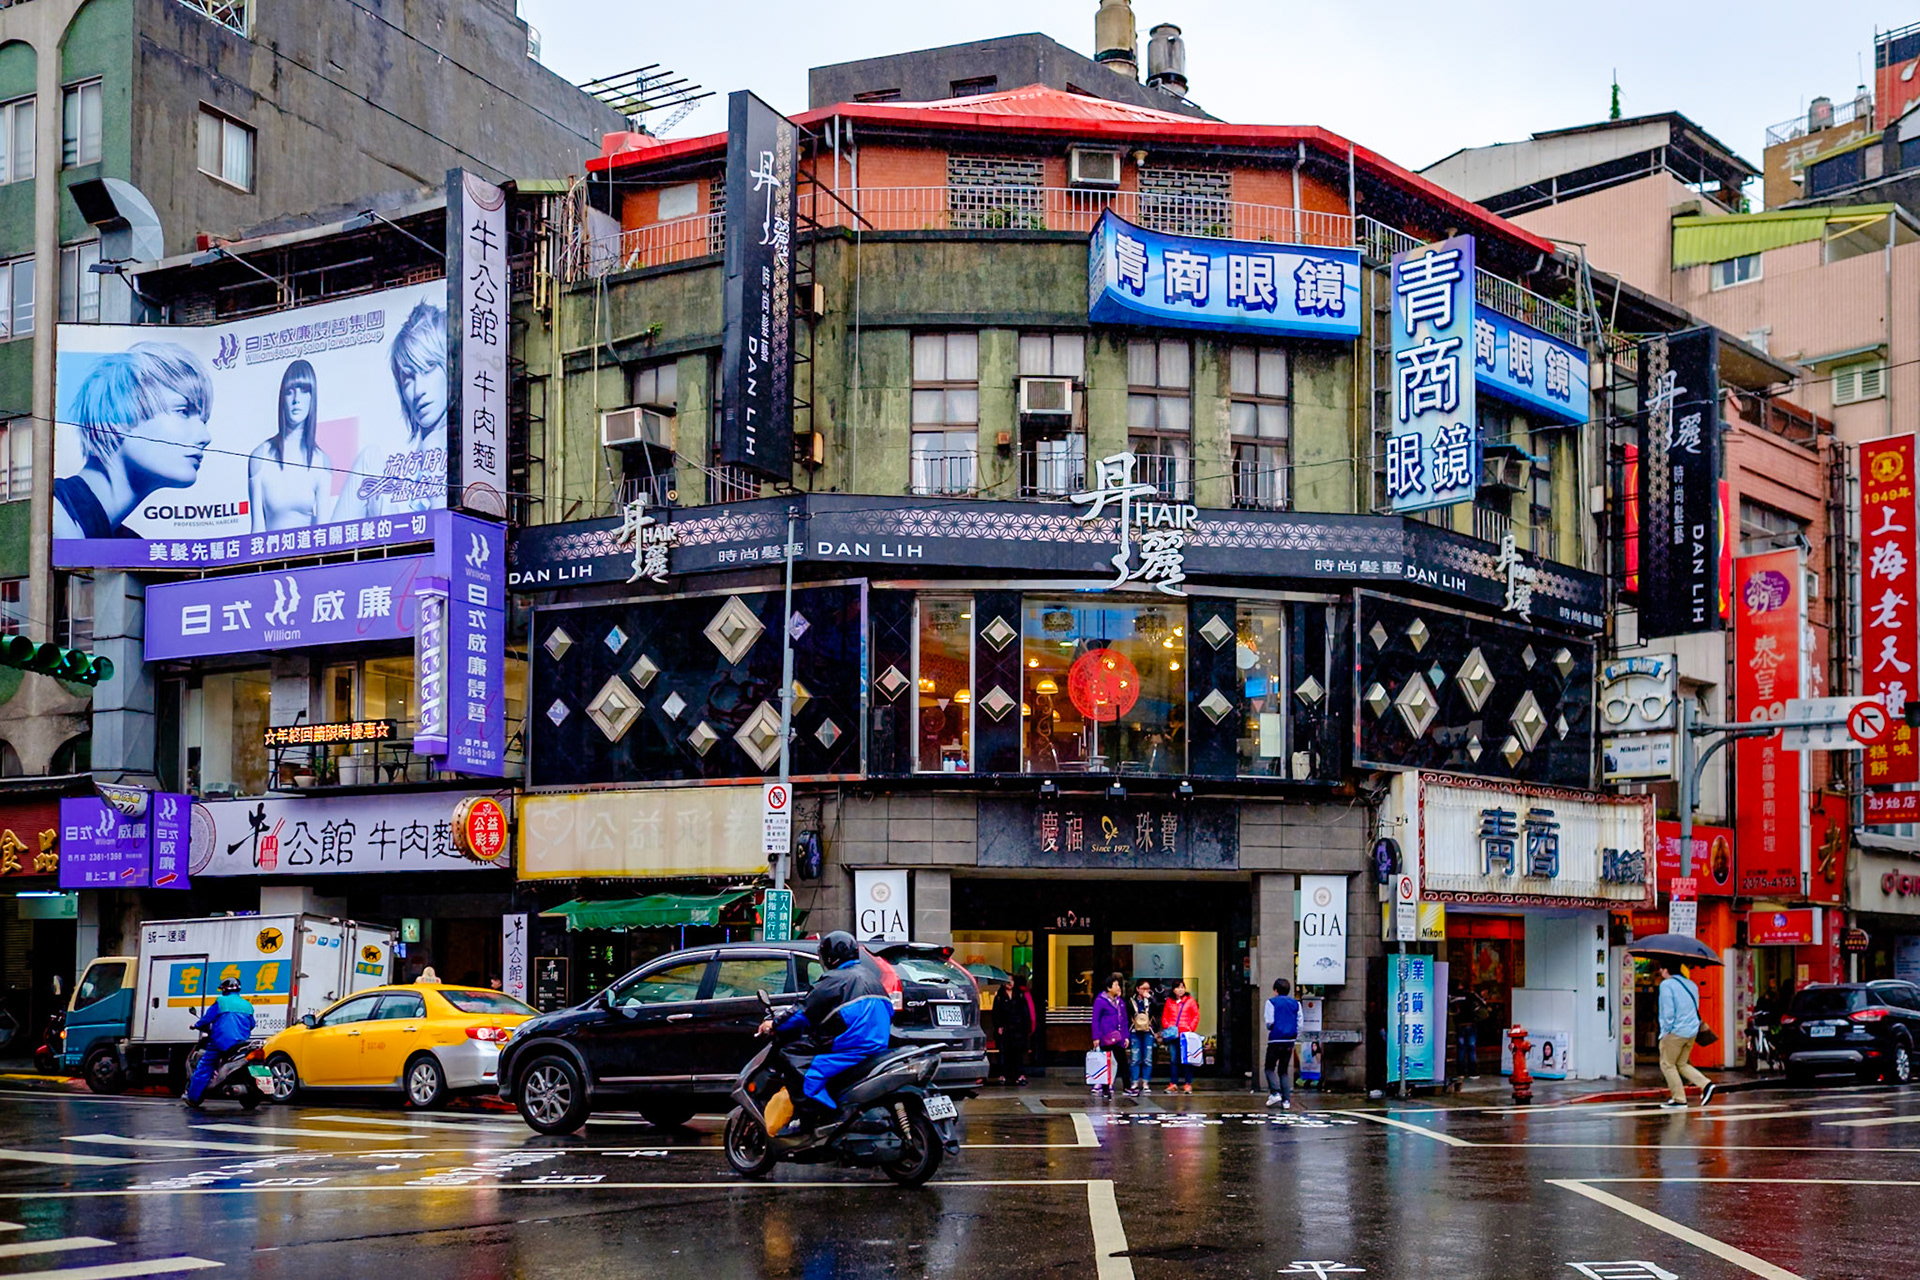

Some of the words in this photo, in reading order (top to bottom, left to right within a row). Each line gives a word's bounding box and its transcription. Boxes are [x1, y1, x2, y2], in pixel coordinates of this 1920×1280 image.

[470, 219, 498, 346] 牛公館
[1115, 232, 1346, 317] 青商眼鏡
[1395, 249, 1462, 423] 青商
[745, 336, 758, 397] DAN
[473, 370, 496, 476] 牛肉麵
[745, 408, 757, 457] LIH
[1386, 422, 1472, 499] 眼鏡
[1864, 487, 1911, 504] 1949年
[144, 502, 239, 520] GOLDWELL
[1070, 451, 1189, 597] 丹麗
[1135, 503, 1200, 529] HAIR
[149, 540, 241, 562] 美髮先驅店
[250, 515, 427, 556] 我們知道有關頭髮的一切
[642, 525, 679, 543] HAIR
[1692, 524, 1705, 574] DAN
[817, 542, 871, 557] DAN
[881, 542, 923, 558] LIH
[509, 569, 550, 584] DAN
[558, 564, 593, 580] LIH
[1407, 564, 1438, 586] DAN
[1442, 572, 1467, 592] LIH
[182, 600, 252, 636] 日式
[311, 585, 392, 623] 威廉
[1692, 583, 1704, 623] LIH
[264, 629, 301, 643] William
[1620, 746, 1641, 754] Nikon
[1893, 725, 1912, 757] 滷味
[1868, 796, 1917, 810] 創始店
[65, 826, 93, 841] 日式
[118, 823, 147, 840] 威廉
[157, 829, 179, 840] 日式
[227, 802, 357, 869] 牛公館
[474, 816, 499, 831] 公益
[1041, 810, 1084, 853] 慶福
[1136, 811, 1178, 854] 珠寶
[0, 828, 59, 875] 食品
[474, 831, 501, 847] 彩券
[1091, 843, 1111, 853] Since
[1113, 844, 1131, 853] 1972
[1478, 806, 1561, 879] 青商
[159, 841, 176, 871] 威廉
[860, 908, 906, 934] GIA
[1302, 912, 1343, 937] GIA
[1422, 927, 1443, 939] Nikon
[505, 916, 524, 981] 牛公館
